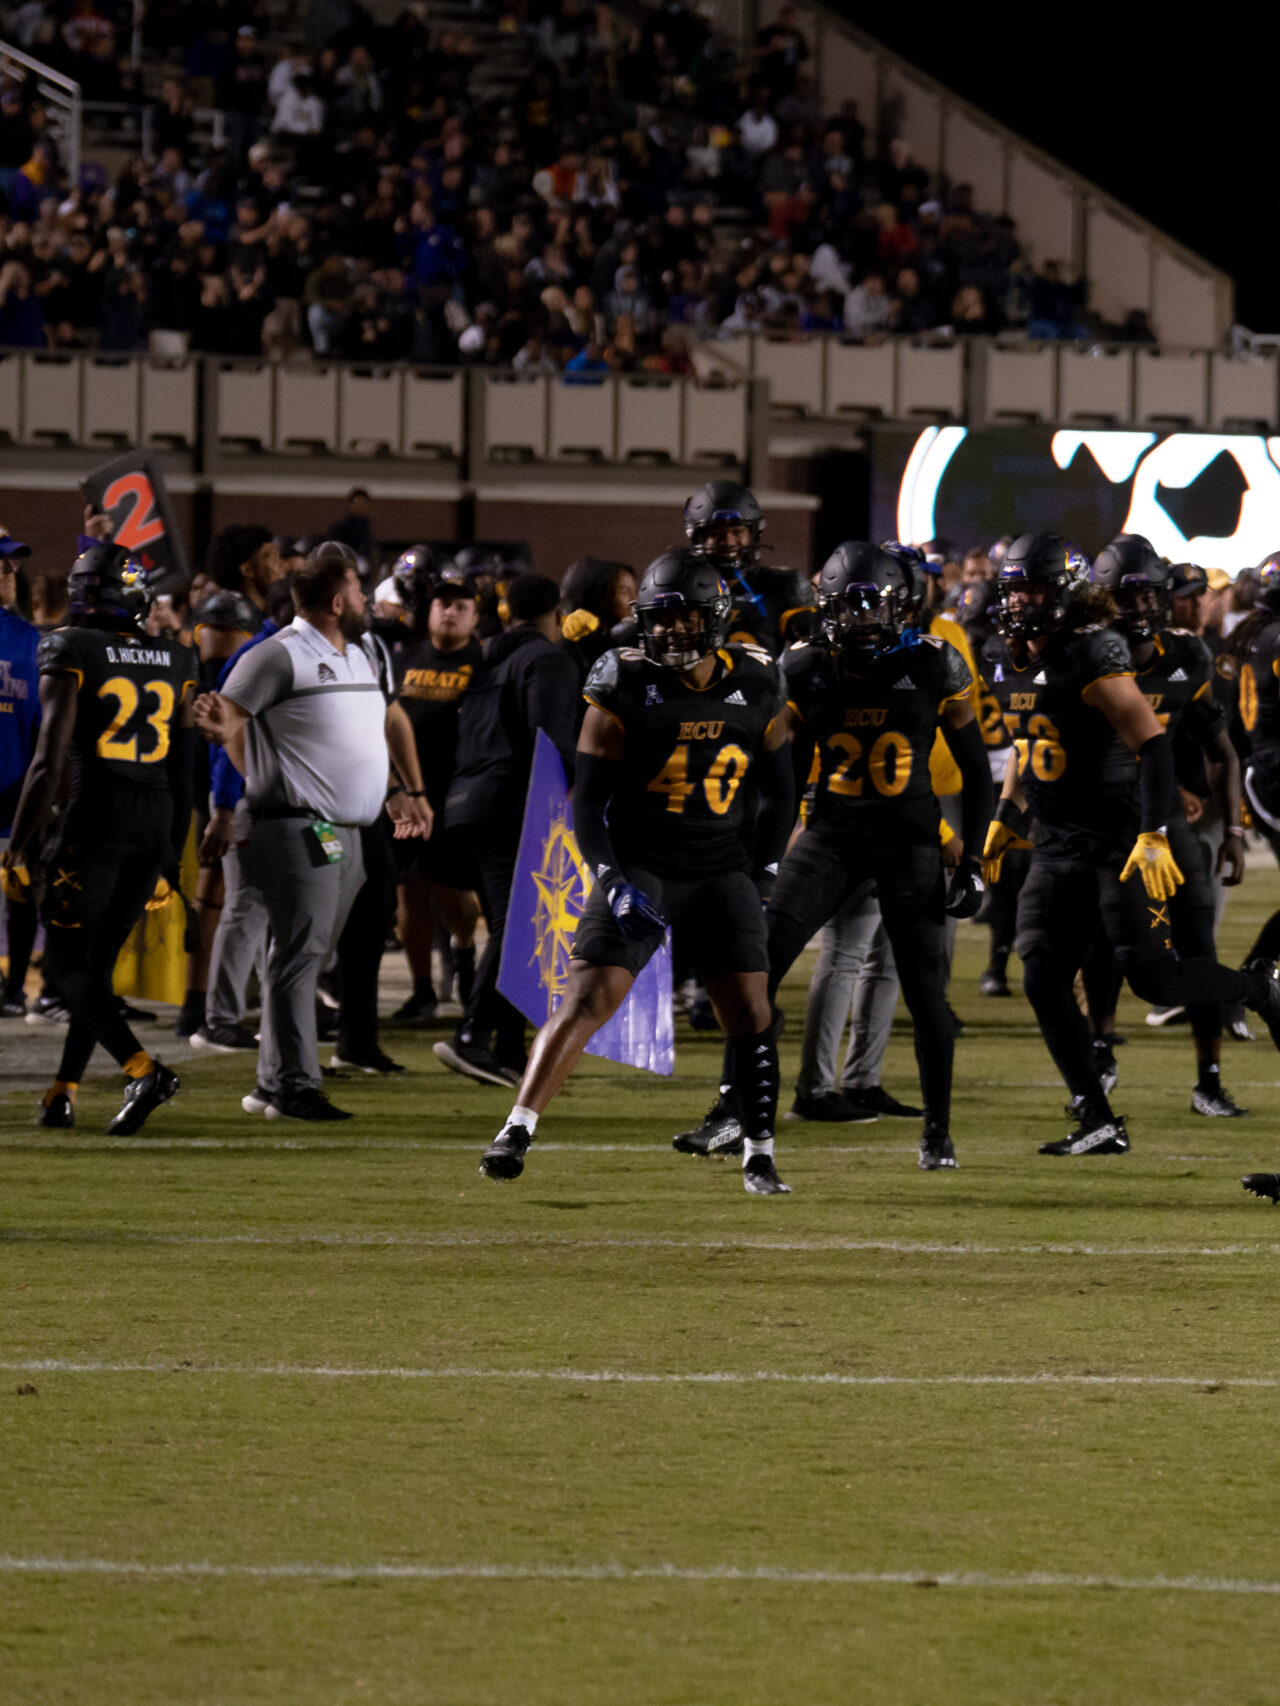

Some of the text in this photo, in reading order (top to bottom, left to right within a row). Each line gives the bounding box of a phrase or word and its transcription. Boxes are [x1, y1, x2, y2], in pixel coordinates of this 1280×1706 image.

[103, 471, 165, 552] 2
[118, 648, 171, 667] HICKMAN
[97, 676, 175, 763] 23
[843, 708, 888, 727] ECU
[1009, 693, 1038, 710] ECU
[676, 721, 725, 741] ECU
[646, 743, 750, 815] 40
[826, 730, 912, 797] 20
